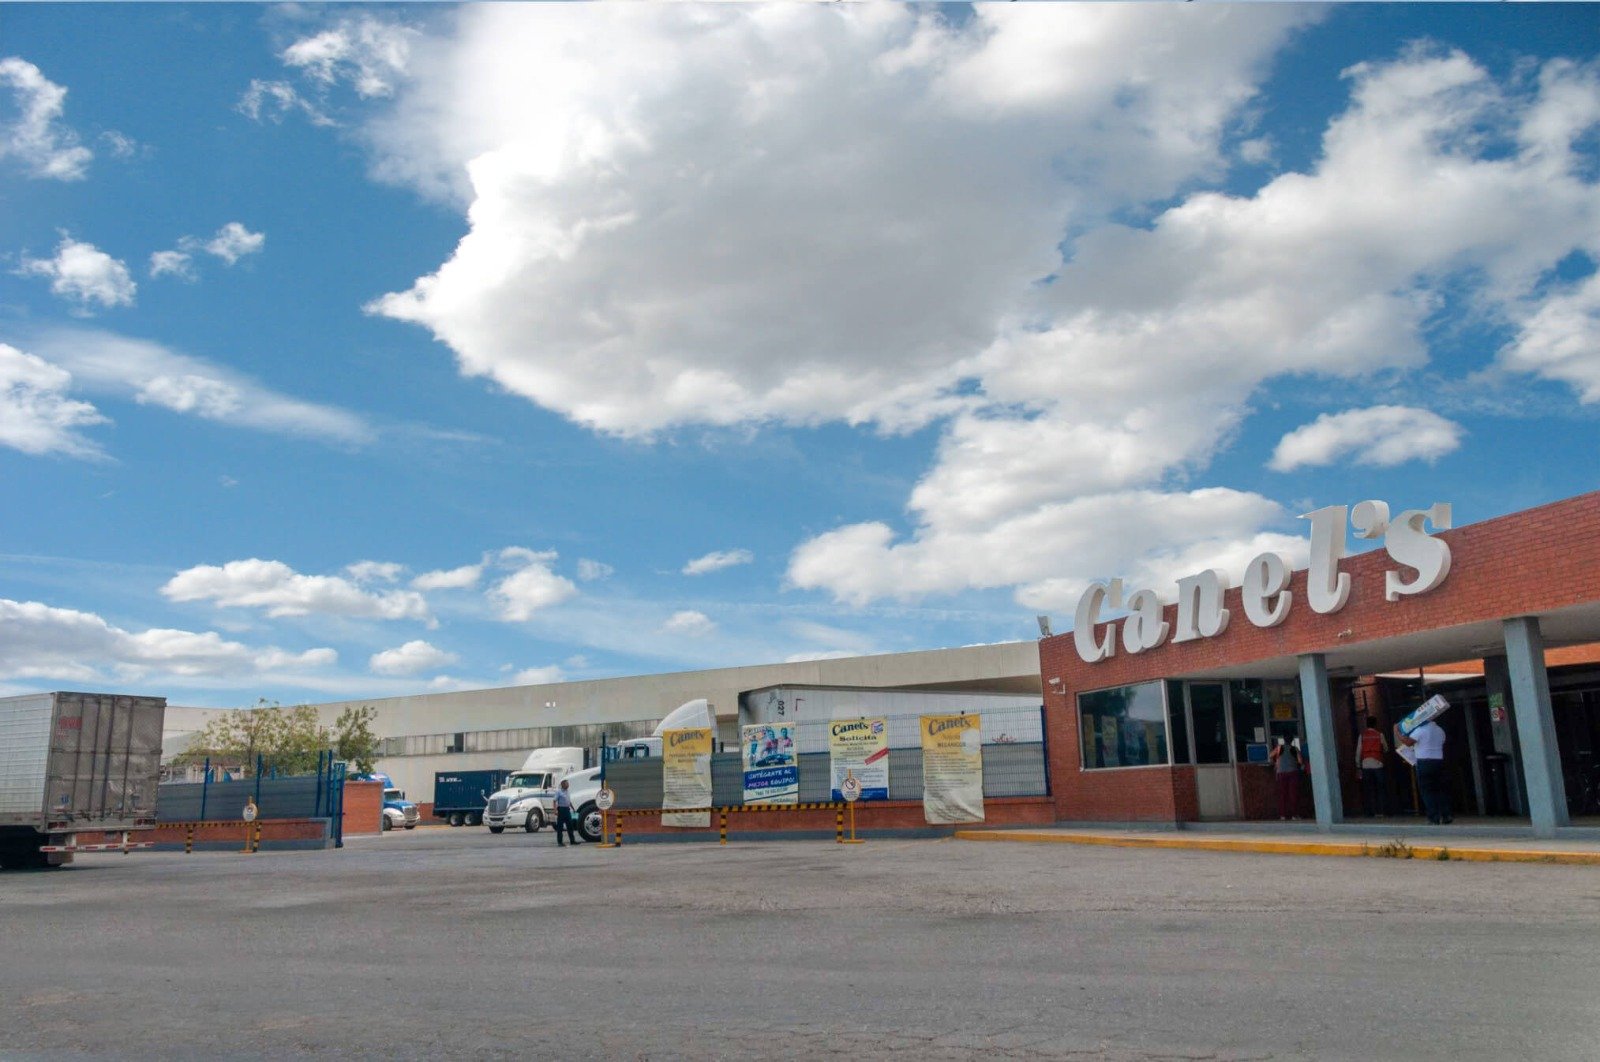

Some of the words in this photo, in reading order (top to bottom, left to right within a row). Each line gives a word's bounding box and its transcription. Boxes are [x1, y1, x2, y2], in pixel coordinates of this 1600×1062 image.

[1073, 500, 1452, 663] Canel's
[777, 700, 785, 716] 027
[832, 721, 869, 736] Canel's
[928, 717, 971, 736] Canel's
[669, 729, 705, 747] Canel's
